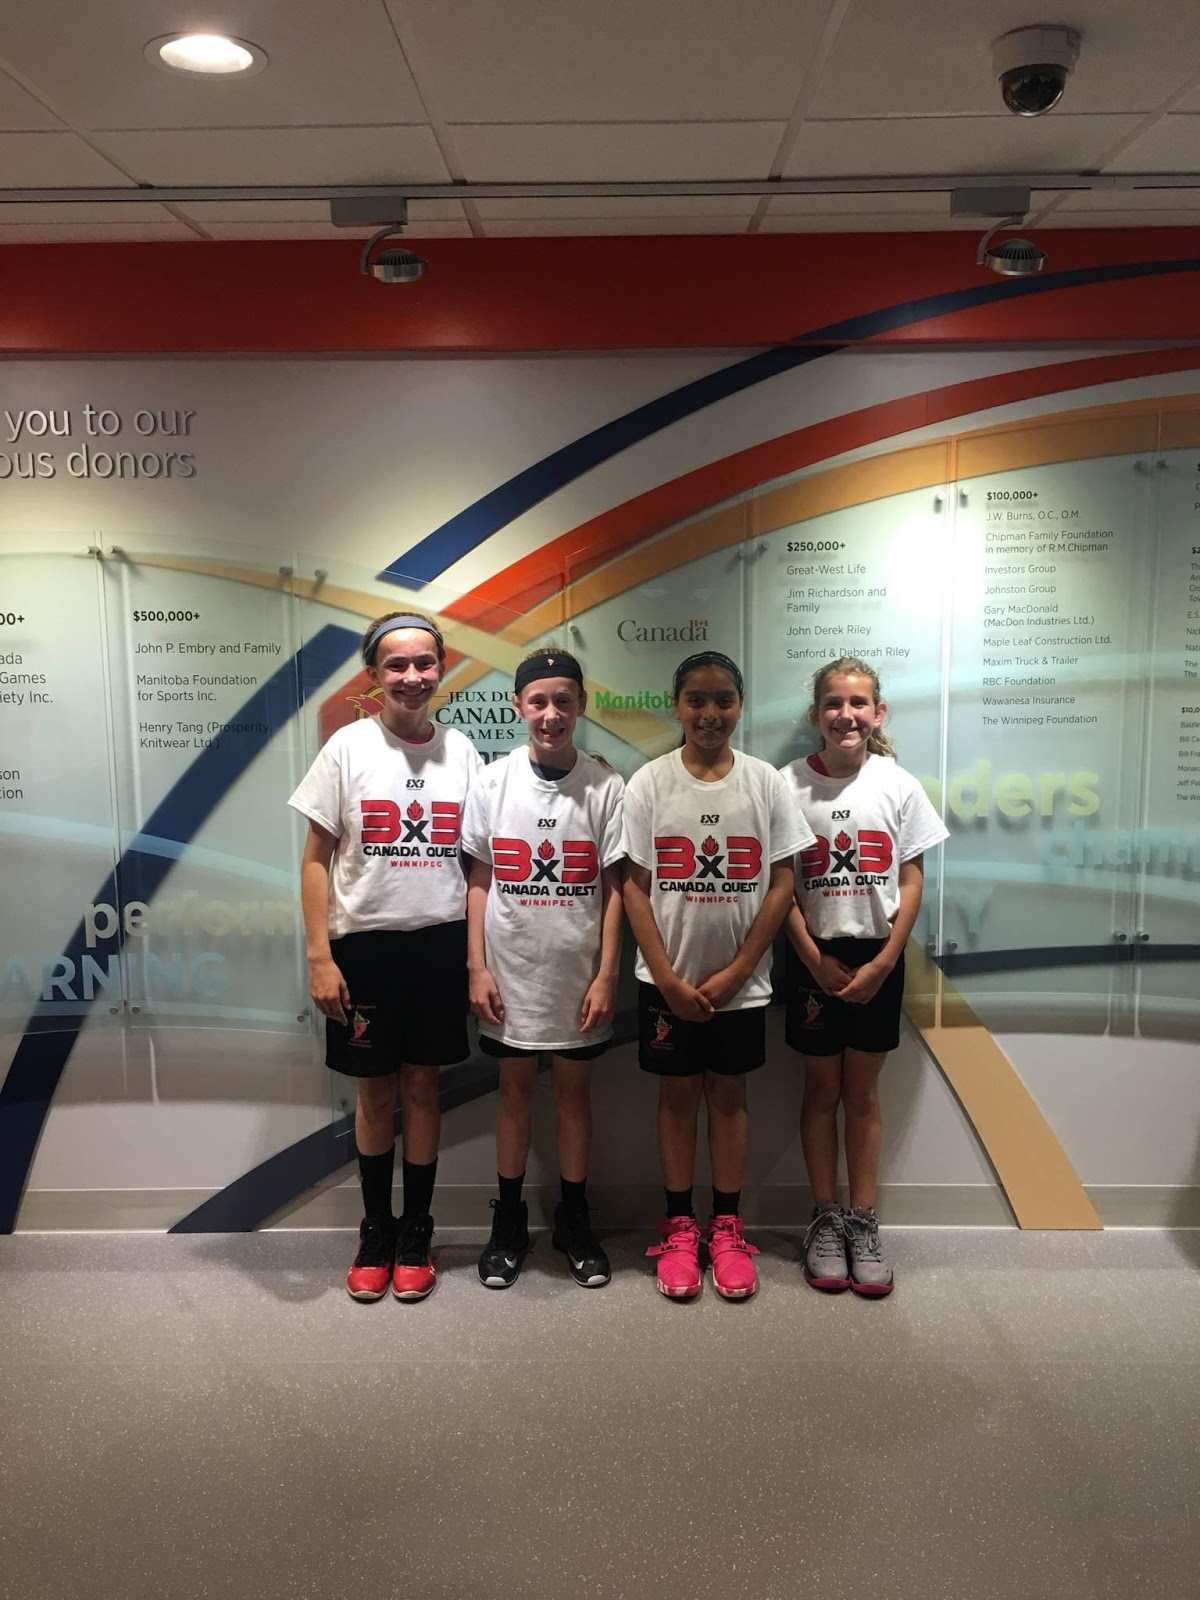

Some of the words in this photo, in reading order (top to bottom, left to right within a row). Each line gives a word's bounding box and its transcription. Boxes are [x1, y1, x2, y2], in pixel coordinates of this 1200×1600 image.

[4, 409, 71, 443] you
[83, 403, 122, 436] to
[133, 409, 196, 436] our
[66, 443, 196, 479] donors
[986, 490, 1039, 501] $100,000+
[986, 512, 1004, 521] J.W.
[1006, 511, 1036, 521] Burns,
[1037, 510, 1059, 520] O.C.,
[1061, 510, 1081, 520] O.M.
[985, 532, 1026, 543] Chipman
[1028, 531, 1059, 541] Family
[1061, 529, 1114, 540] Foundation
[786, 541, 846, 553] $250,000+
[985, 545, 994, 554] in
[996, 545, 1034, 555] memory
[1036, 543, 1047, 553] of
[786, 564, 844, 576] Great-West
[847, 563, 867, 574] Life
[984, 565, 1026, 574] Investors
[1027, 564, 1057, 574] Group
[786, 588, 805, 599] Jim
[807, 587, 865, 598] Richardson
[867, 586, 887, 597] and
[984, 585, 1026, 595] Johnston
[1028, 584, 1057, 595] Group
[786, 602, 820, 614] Family
[984, 605, 1005, 616] Gary
[1008, 604, 1059, 614] MacDonald
[133, 610, 200, 623] $500,000+
[983, 617, 1024, 628] (MacDon
[1026, 616, 1071, 626] Industries
[1073, 615, 1095, 626] Ltd.)
[617, 619, 708, 642] Canada
[786, 626, 811, 636] John
[814, 625, 844, 635] Derek
[847, 624, 872, 636] Riley
[983, 637, 1011, 648] Maple
[1012, 636, 1032, 646] Leaf
[1034, 635, 1093, 646] Construction
[1094, 635, 1113, 645] Ltd.
[135, 643, 163, 654] John
[166, 643, 175, 653] P.
[178, 642, 216, 655] Embry
[219, 642, 241, 653] and
[244, 642, 282, 655] Family
[786, 648, 826, 659] Sanford
[828, 648, 837, 658] &
[839, 647, 883, 658] Deborah
[885, 646, 910, 659] Riley
[983, 657, 1012, 666] Maxim
[1015, 656, 1040, 666] Truck
[1041, 656, 1049, 665] &
[1051, 655, 1079, 665] Trailer
[0, 671, 47, 684] Games
[136, 674, 190, 686] Manitoba
[193, 674, 257, 685] Foundation
[982, 677, 1002, 686] RBC
[1004, 676, 1056, 686] Foundation
[29, 691, 53, 703] Inc.
[137, 690, 154, 701] for
[157, 690, 194, 703] Sports
[197, 690, 217, 701] Inc.
[448, 691, 485, 704] JEUX
[595, 690, 673, 710] Manitob
[982, 697, 1030, 706] Wawanesa
[1032, 696, 1076, 705] Insurance
[982, 716, 999, 725] The
[1000, 715, 1044, 726] Winnipeg
[1046, 715, 1098, 724] Foundation
[139, 722, 173, 734] Henry
[176, 721, 204, 735] Tang
[207, 721, 270, 734] (Prosperity
[460, 728, 515, 740] AMES
[140, 738, 190, 749] Knitwear
[193, 737, 220, 749] Ltd.)
[0, 786, 24, 799] ion
[363, 845, 421, 857] CANADA
[426, 846, 457, 858] QUES
[390, 860, 443, 868] WINNIPEG
[855, 874, 889, 886] QUEST
[555, 885, 597, 897] QUEST
[659, 881, 716, 893] CANADA
[721, 882, 759, 893] QUEST
[822, 888, 873, 898] WINNIPEG
[519, 898, 574, 907] WINNIPEG
[685, 895, 738, 904] WINNIPEG
